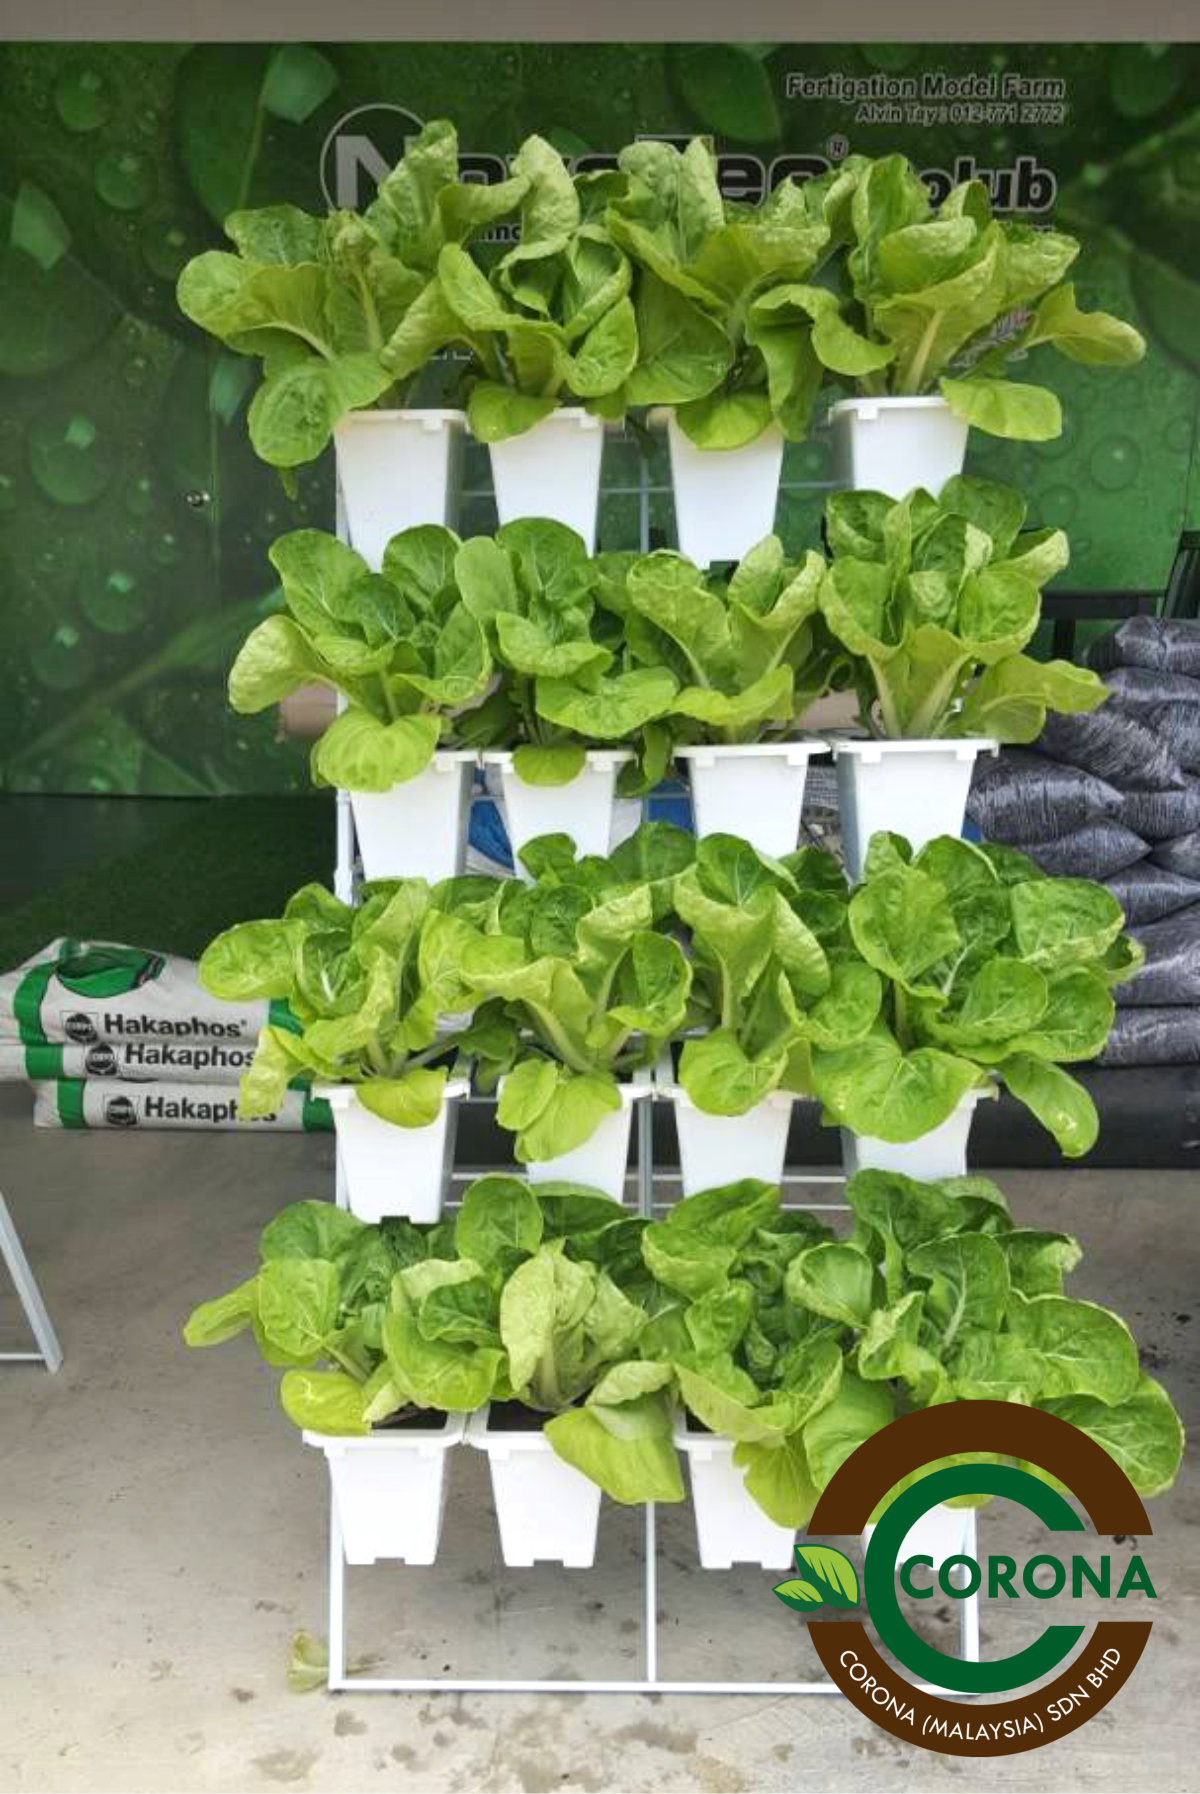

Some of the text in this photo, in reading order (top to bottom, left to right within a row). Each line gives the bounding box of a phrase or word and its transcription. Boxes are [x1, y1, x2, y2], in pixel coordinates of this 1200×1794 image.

[787, 73, 1067, 102] Fertigation Model Farm
[856, 103, 901, 124] Alvin
[103, 1013, 242, 1038] Hakaphos
